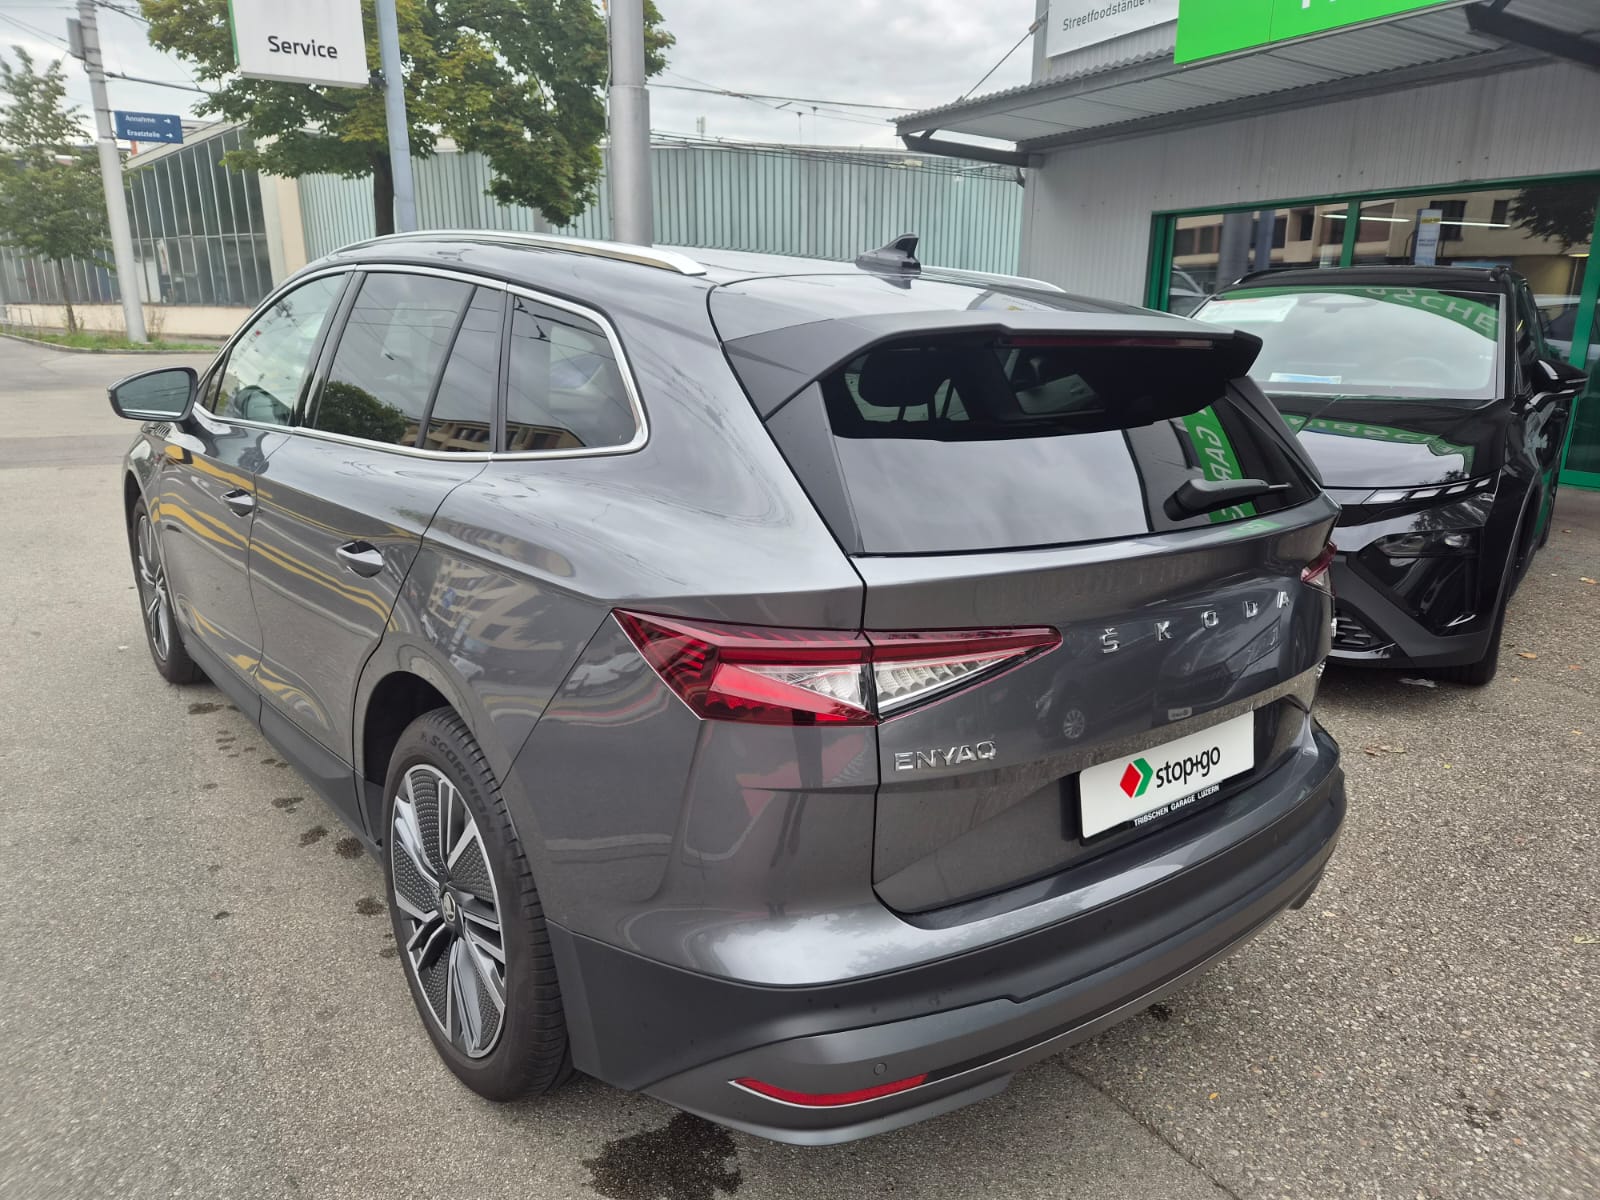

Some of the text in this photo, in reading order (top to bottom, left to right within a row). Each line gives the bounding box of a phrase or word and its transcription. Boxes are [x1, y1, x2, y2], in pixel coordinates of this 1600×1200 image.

[267, 35, 338, 59] Service
[125, 114, 156, 124] Annahme
[126, 129, 161, 139] Ersatzteile
[1101, 591, 1291, 654] ŠKODA
[894, 740, 997, 772] ENYAQ
[1155, 745, 1221, 788] stop+go
[430, 734, 495, 833] SCORPION
[1133, 784, 1220, 827] TRIBSCHEN GARAGE LUZERN
